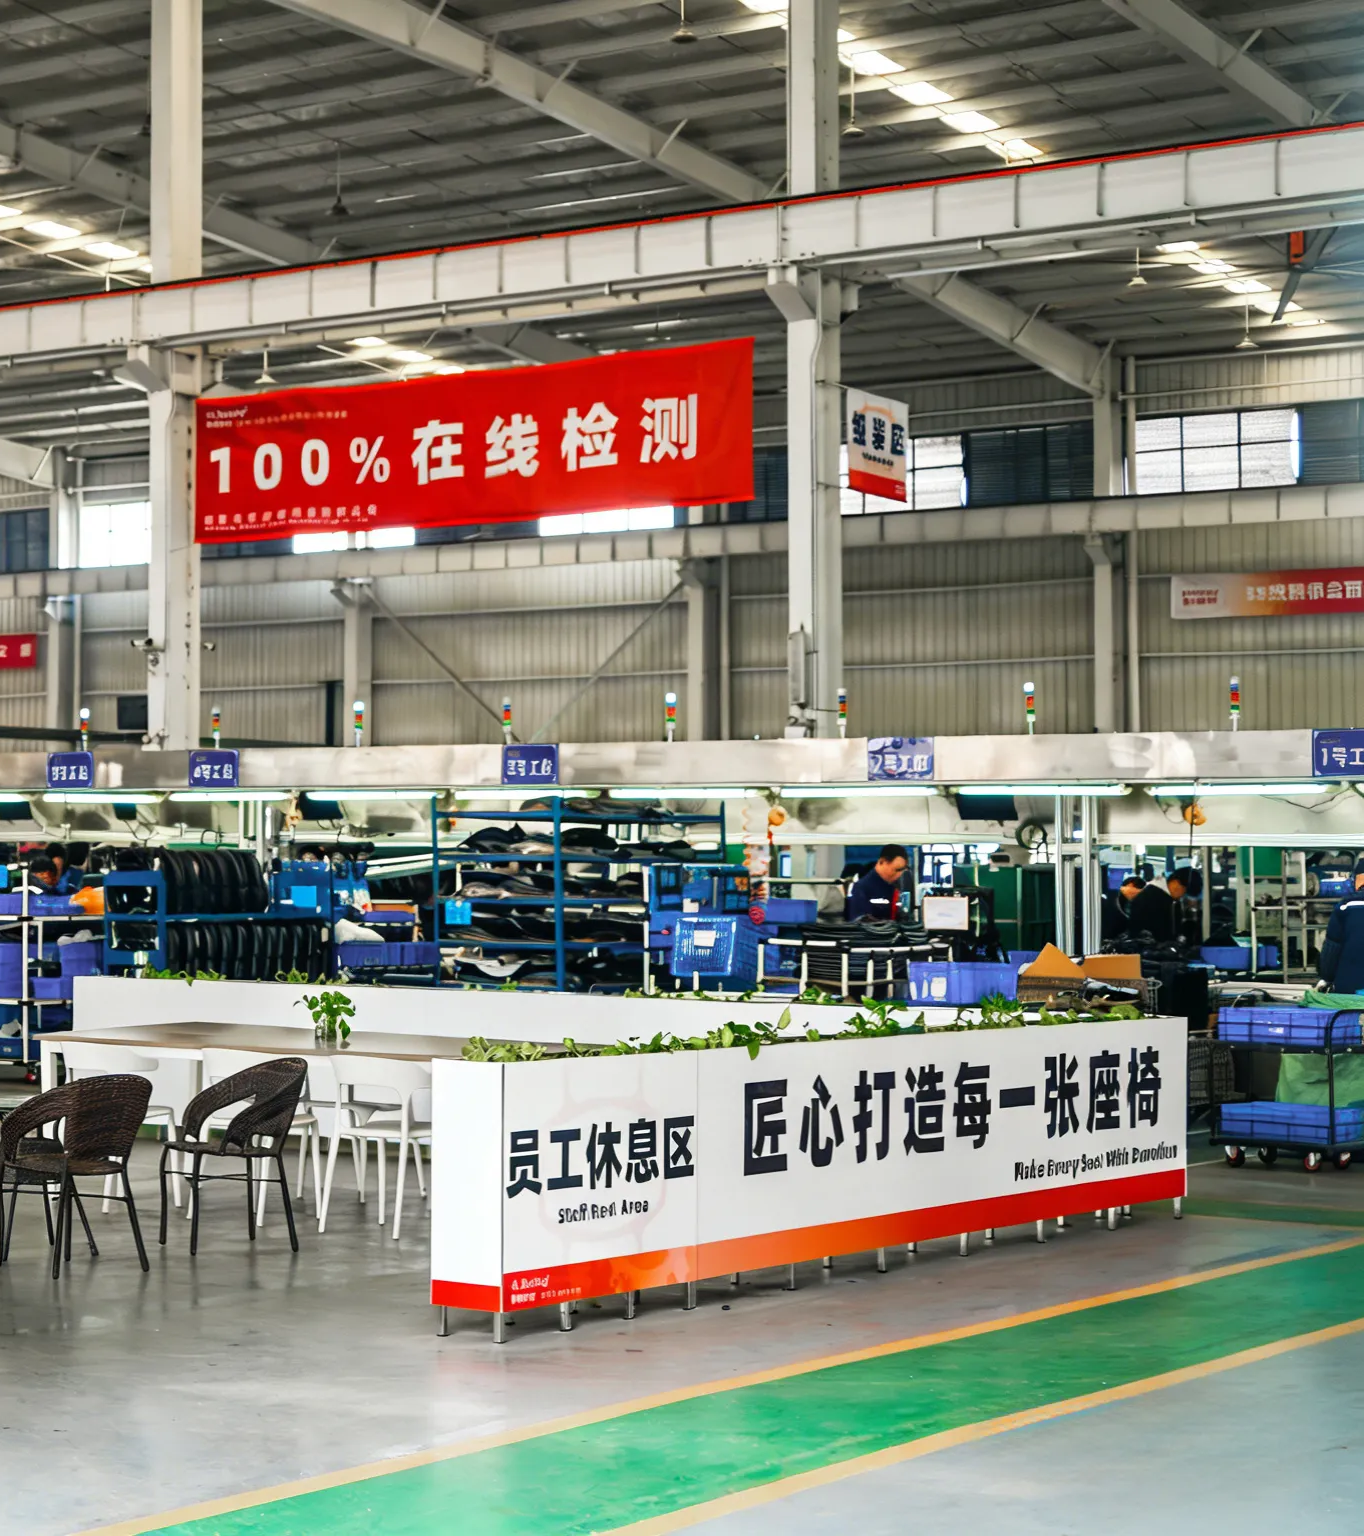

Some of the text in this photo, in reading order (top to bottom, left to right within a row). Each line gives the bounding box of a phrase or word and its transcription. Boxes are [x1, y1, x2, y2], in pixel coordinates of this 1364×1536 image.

[210, 393, 699, 493] 100%在线检测
[507, 1115, 695, 1199] 员工休息区
[743, 1045, 1162, 1176] 匠心打造每一张座椅
